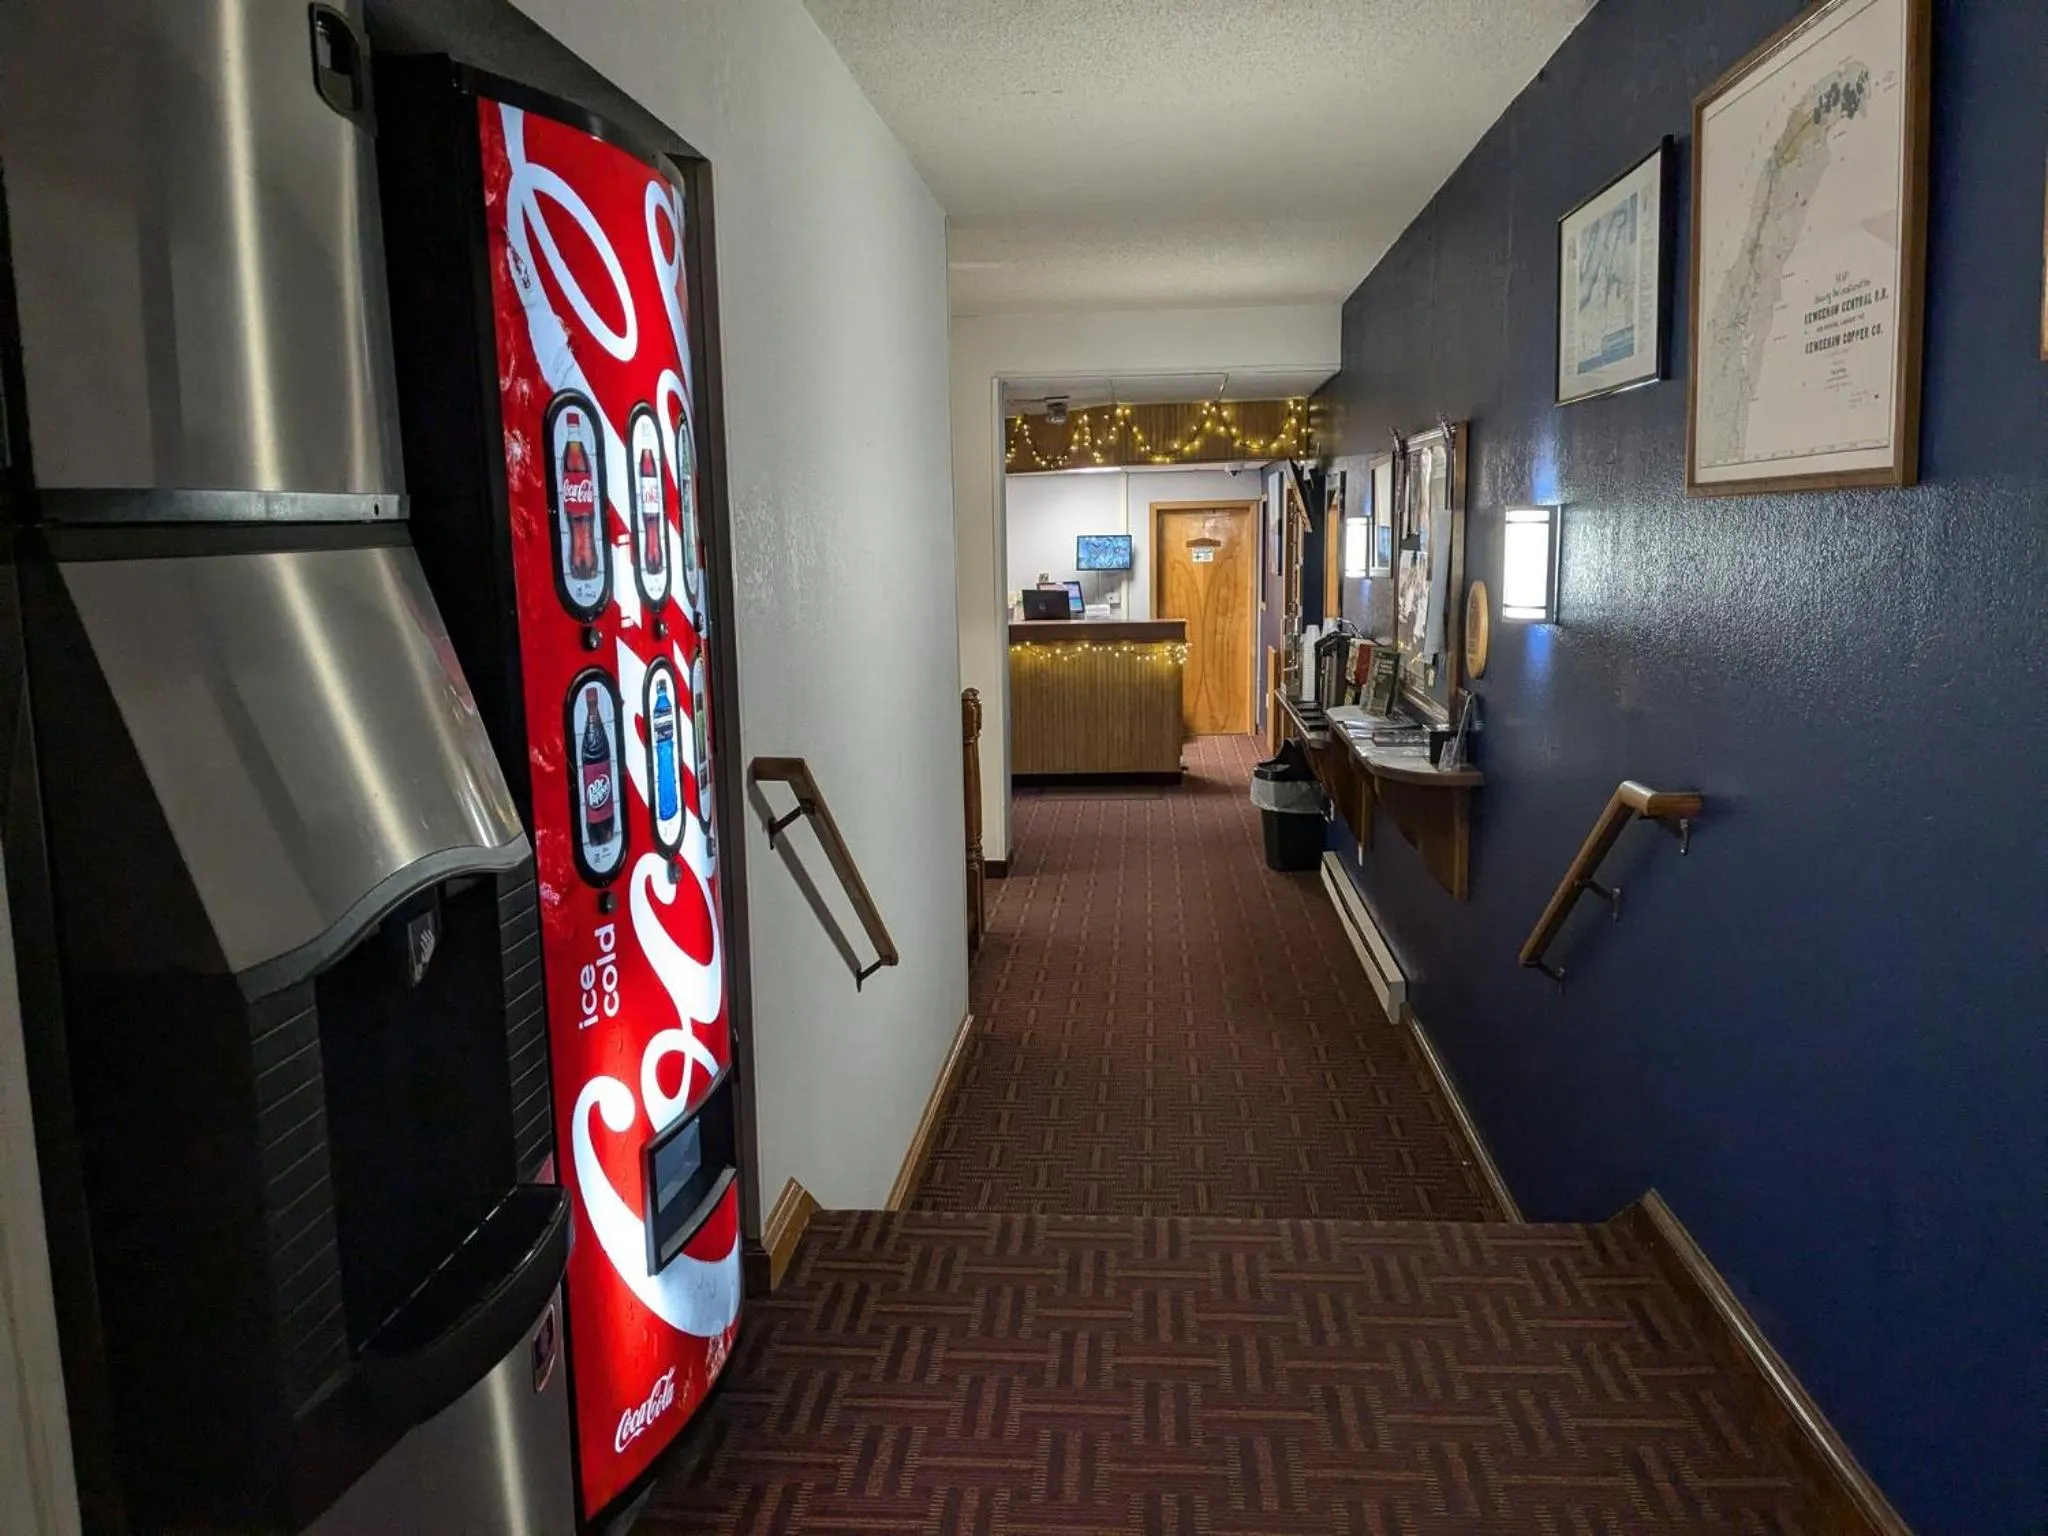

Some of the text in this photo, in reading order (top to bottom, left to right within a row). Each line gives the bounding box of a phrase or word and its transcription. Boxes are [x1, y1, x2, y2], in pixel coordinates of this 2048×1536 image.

[579, 964, 599, 1030] ice
[594, 923, 620, 1018] cold
[614, 1366, 677, 1454] Coca-Cola
